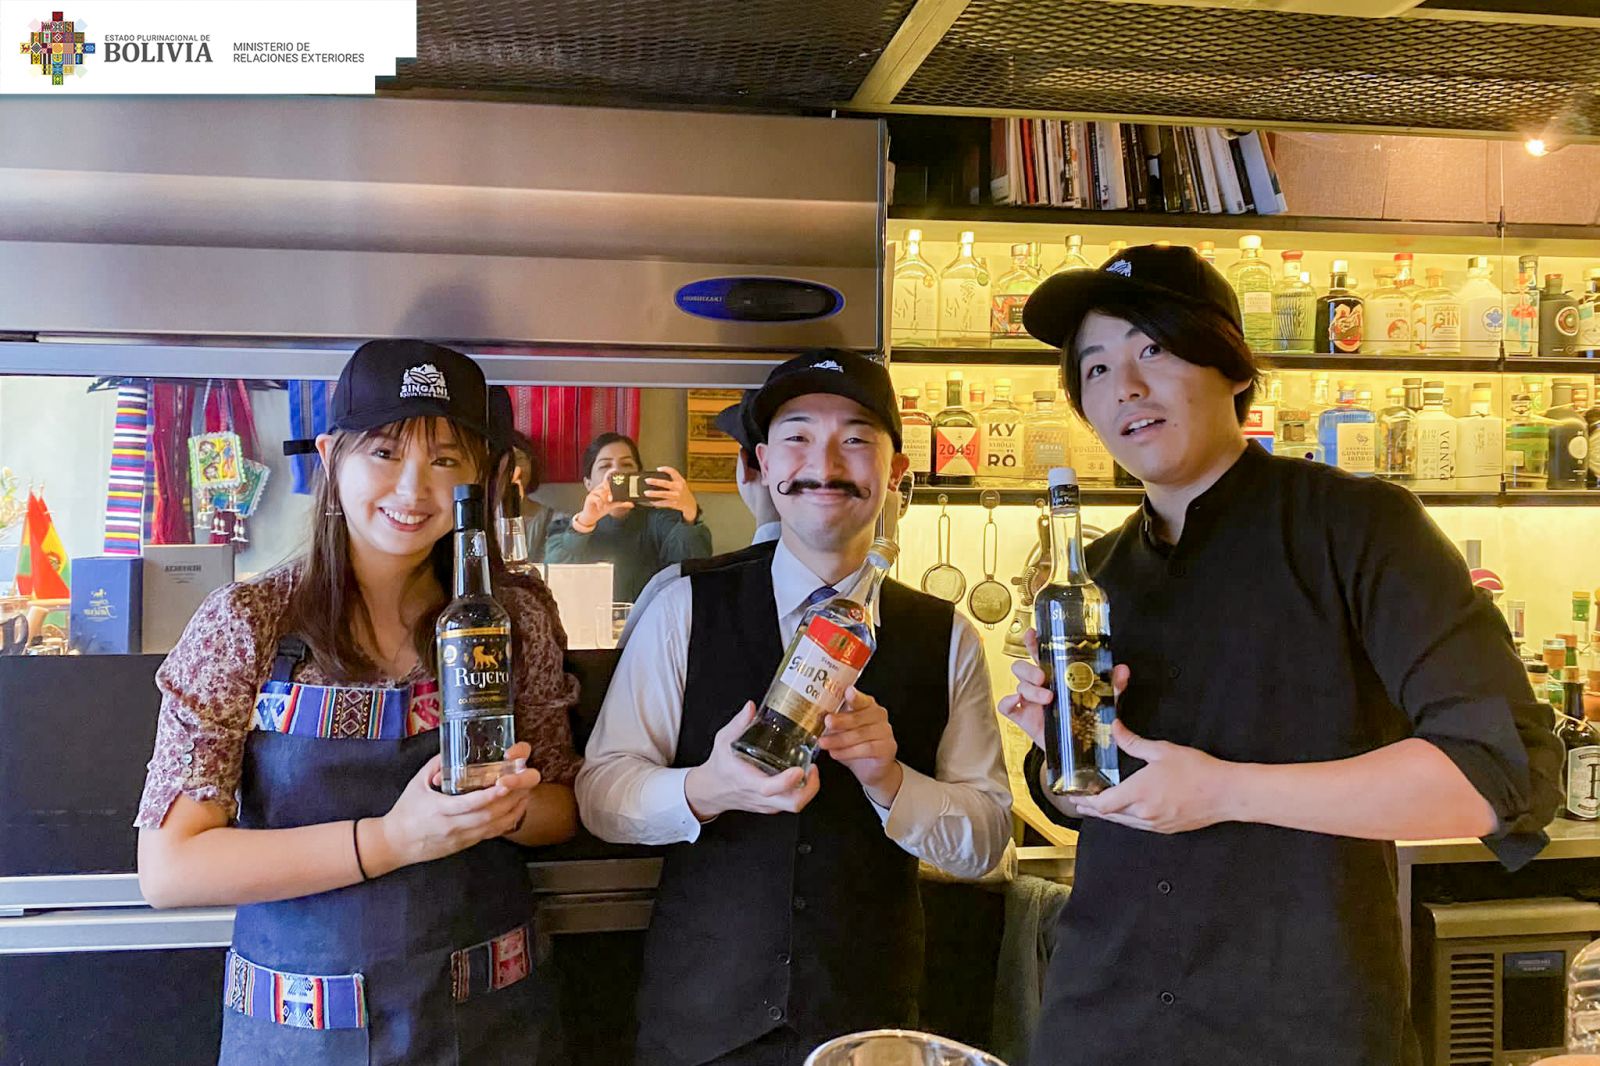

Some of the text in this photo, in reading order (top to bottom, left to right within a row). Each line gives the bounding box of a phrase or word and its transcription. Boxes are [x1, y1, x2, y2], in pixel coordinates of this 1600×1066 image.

[401, 384, 448, 397] SINGANI
[988, 423, 1016, 437] KY
[987, 449, 1017, 467] RÖ
[1439, 430, 1450, 481] PANDA
[454, 667, 509, 689] Rujero
